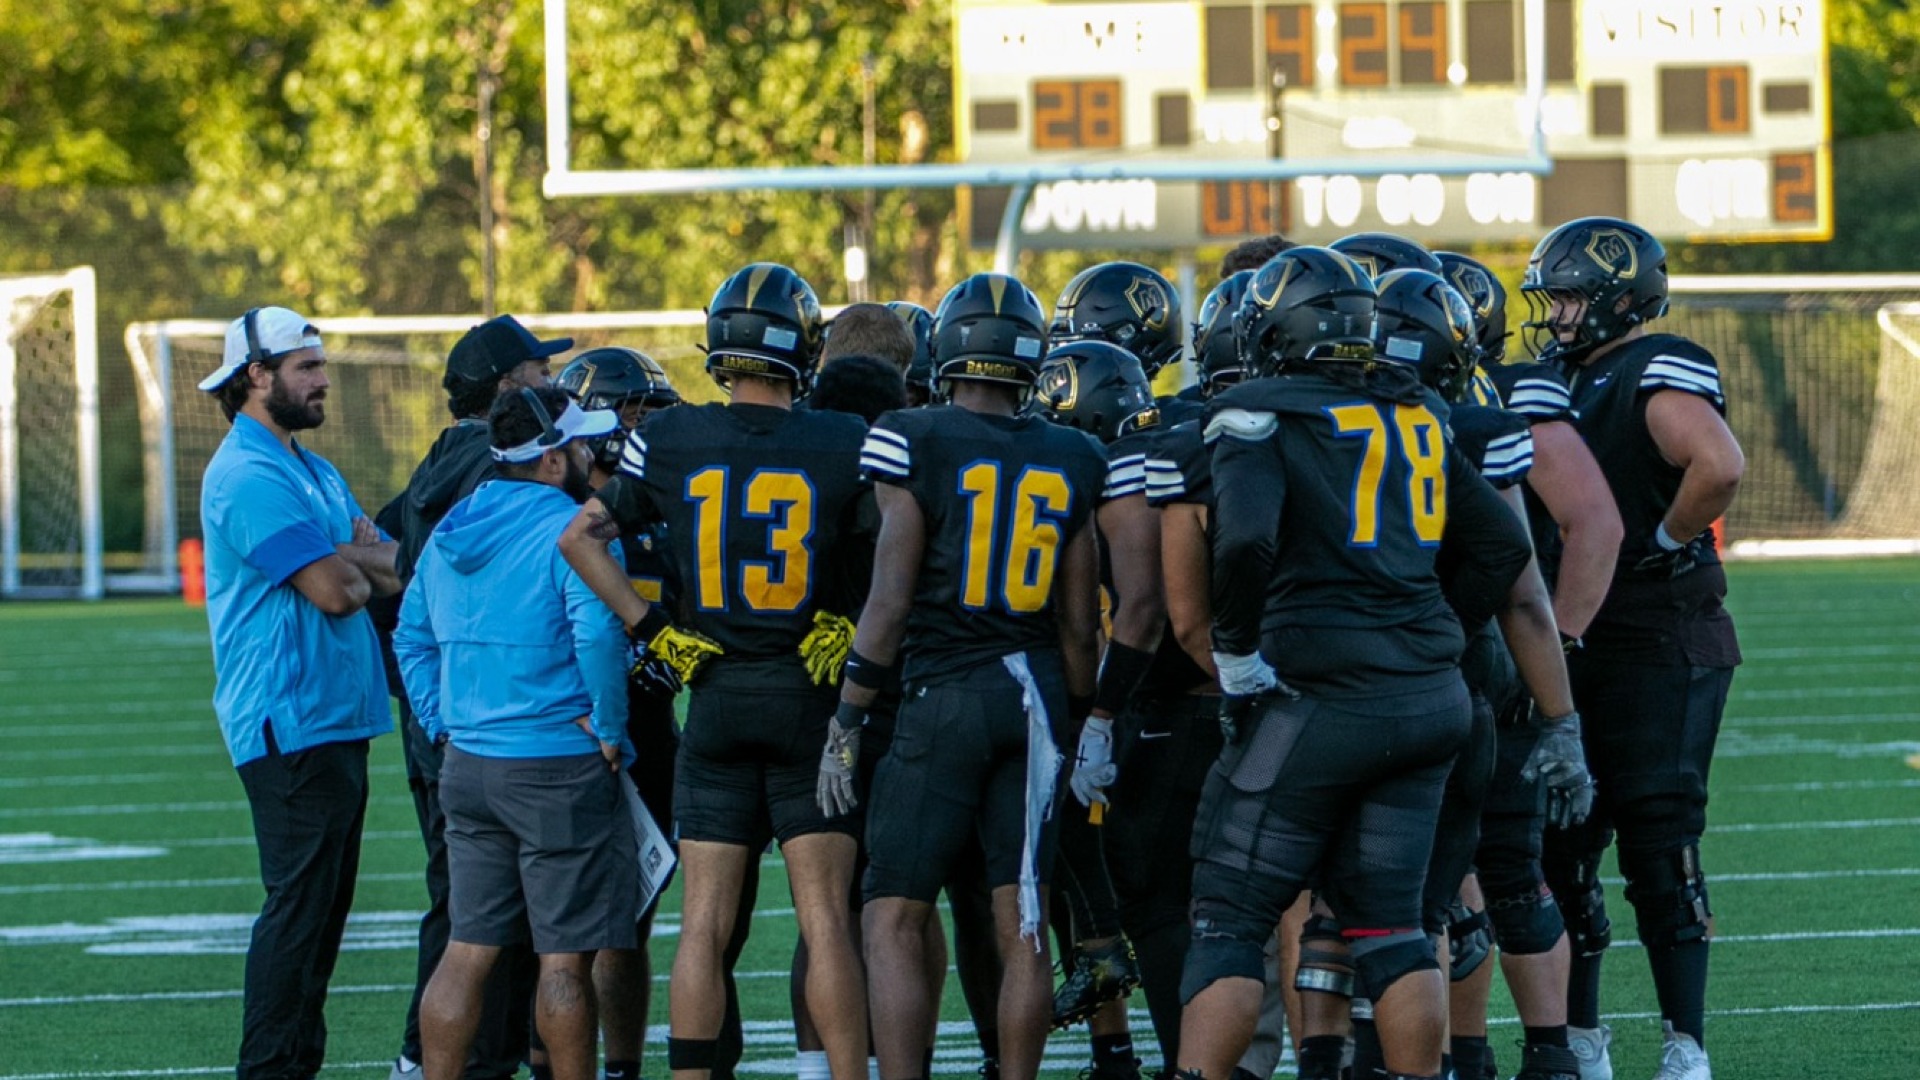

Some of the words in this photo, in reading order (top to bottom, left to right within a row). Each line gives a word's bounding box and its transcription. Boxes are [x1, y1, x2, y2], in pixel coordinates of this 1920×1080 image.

[1034, 79, 1122, 150] 28
[1706, 65, 1749, 134] 0
[1296, 174, 1362, 227] TO
[1773, 151, 1816, 223] 2
[1321, 400, 1449, 549] 78
[684, 463, 817, 614] 13
[957, 458, 1074, 616] 16
